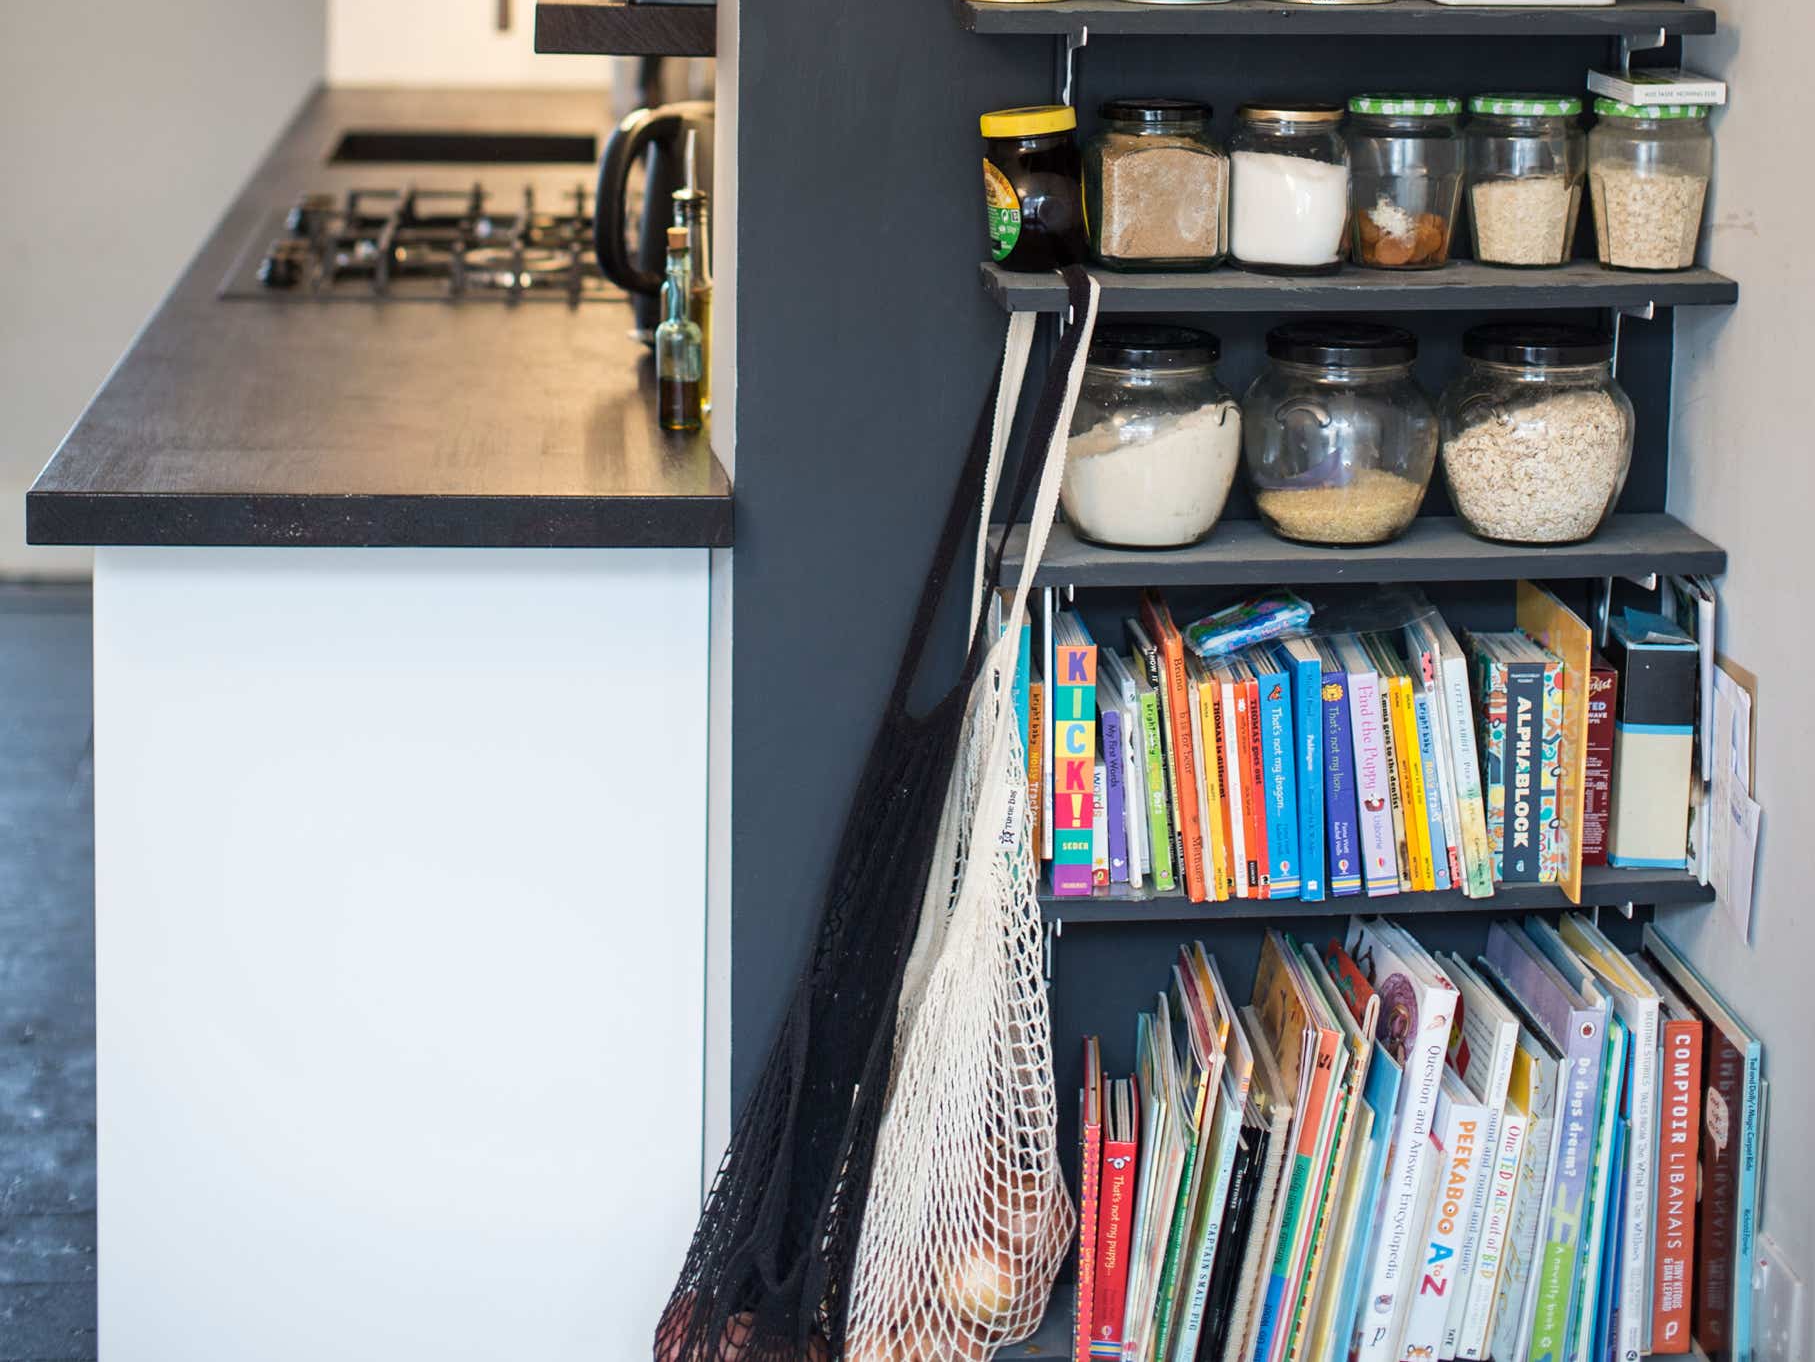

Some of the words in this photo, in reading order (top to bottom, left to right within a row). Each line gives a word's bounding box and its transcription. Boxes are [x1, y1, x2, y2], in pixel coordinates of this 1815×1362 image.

[1174, 658, 1184, 691] Bruna
[1358, 686, 1375, 716] Find
[1380, 692, 1389, 722] Emma
[1453, 683, 1463, 715] LITTLE
[1180, 721, 1189, 732] is
[1213, 701, 1222, 742] THOMAS
[1250, 699, 1260, 743] THOMAS
[1272, 707, 1283, 736] That's
[1329, 706, 1340, 734] That's
[1418, 702, 1428, 731] bright
[1032, 723, 1040, 745] baby
[1065, 651, 1089, 828] KICK!
[1106, 725, 1117, 739] My
[1181, 733, 1191, 747] for
[1273, 739, 1282, 752] not
[1330, 737, 1339, 753] not
[1361, 721, 1377, 744] the
[1382, 724, 1392, 744] goes
[1421, 733, 1431, 753] baby
[1457, 719, 1468, 753] RABBIT
[1108, 740, 1118, 758] First
[1216, 746, 1223, 755] is
[1251, 746, 1261, 765] goes
[1385, 746, 1393, 755] to
[1109, 760, 1120, 787] Words
[1182, 754, 1192, 774] bear
[1216, 755, 1225, 798] different
[1254, 768, 1262, 785] out
[1272, 755, 1283, 773] my
[1331, 756, 1341, 771] my
[1360, 747, 1379, 789] Puppy
[1387, 758, 1396, 773] the
[1513, 696, 1532, 848] ALPHABLOCK
[1389, 775, 1399, 810] dentist
[1374, 815, 1385, 850] Usborne
[1192, 836, 1202, 883] Methuen
[1448, 850, 1458, 881] Ladybird
[1644, 1011, 1654, 1048] BEDTIME
[1418, 1045, 1442, 1105] Question
[1578, 1057, 1591, 1075] Do
[1642, 1051, 1651, 1086] STORIES
[1749, 1057, 1757, 1071] Ted
[1571, 1080, 1588, 1117] dogs
[1671, 1034, 1691, 1144] COMPTOIR
[1747, 1085, 1756, 1110] Dolly's
[1639, 1092, 1648, 1115] TALES
[1413, 1109, 1429, 1135] and
[1485, 1108, 1499, 1143] round
[1639, 1116, 1648, 1141] FROM
[1745, 1111, 1754, 1131] Magic
[1504, 1125, 1521, 1153] One
[1564, 1122, 1585, 1177] dream?
[1745, 1132, 1753, 1155] Carpet
[1402, 1140, 1423, 1188] Answer
[1480, 1147, 1493, 1169] and
[1499, 1155, 1517, 1180] TED
[1112, 1175, 1124, 1202] That's
[1231, 1170, 1243, 1209] GEMSTONES
[1438, 1120, 1477, 1235] PEEKABOO
[1472, 1173, 1487, 1209] round
[1494, 1183, 1512, 1215] FALLS
[1667, 1153, 1684, 1249] LIBANAIS
[1111, 1205, 1119, 1221] not
[1468, 1211, 1482, 1234] and
[1490, 1215, 1502, 1235] out
[1743, 1209, 1751, 1234] Richard
[1107, 1224, 1118, 1239] my
[1385, 1193, 1412, 1280] Encyclopedia
[1486, 1238, 1499, 1252] of
[1631, 1222, 1642, 1261] Willows
[1105, 1241, 1117, 1276] puppy...
[1201, 1223, 1217, 1269] CAPTAIN
[1274, 1231, 1289, 1266] Miranda
[1427, 1242, 1454, 1265] A
[1460, 1235, 1476, 1275] square
[1557, 1247, 1565, 1255] A
[1433, 1264, 1444, 1277] to
[1480, 1254, 1497, 1280] BED
[1545, 1257, 1563, 1299] novelty
[1664, 1266, 1672, 1281] DAN
[1673, 1261, 1684, 1280] TONY
[1192, 1274, 1208, 1308] SMALL
[1420, 1273, 1447, 1296] Z
[1662, 1282, 1672, 1312] LEPARD
[1673, 1282, 1683, 1309] KITOUS
[1188, 1313, 1199, 1331] PIG
[1543, 1303, 1557, 1331] book
[1445, 1328, 1456, 1347] TATE
